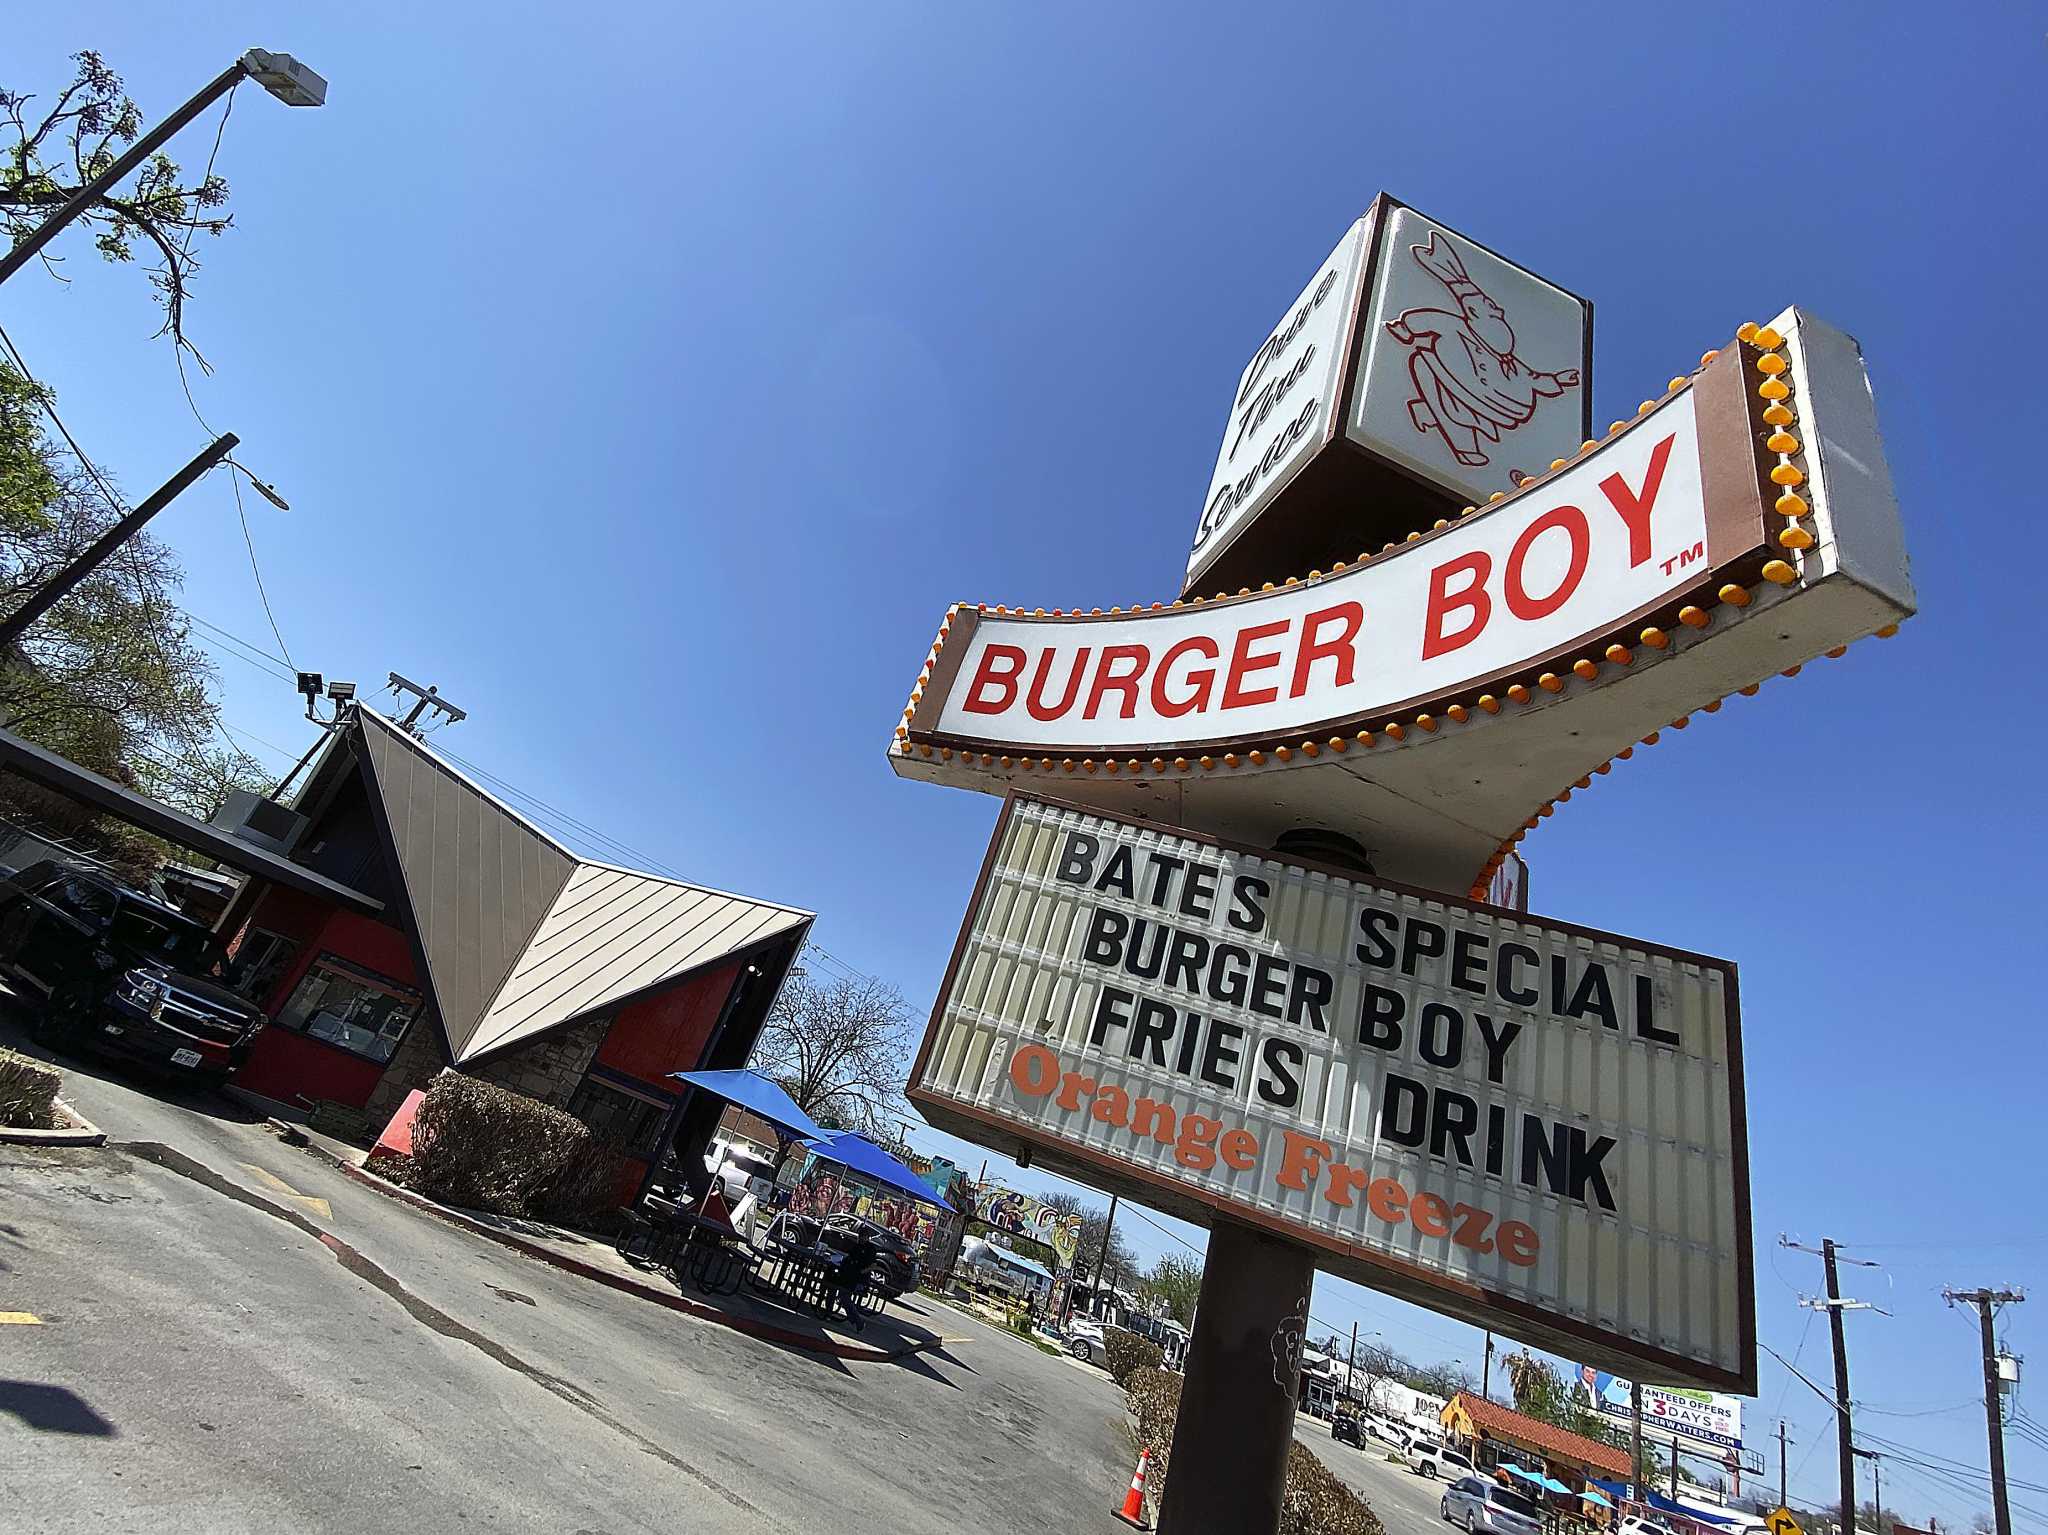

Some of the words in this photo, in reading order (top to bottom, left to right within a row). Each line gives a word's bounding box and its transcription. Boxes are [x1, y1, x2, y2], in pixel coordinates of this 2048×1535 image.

[1229, 344, 1316, 462] Thru
[1238, 269, 1337, 408] Drive
[1192, 398, 1319, 553] Service
[962, 600, 1364, 722] BURGER
[1422, 432, 1677, 661] BOY
[1055, 831, 1271, 933] BATES
[1356, 907, 1680, 1046] SPECIAL
[1083, 907, 1334, 1034] BURGER
[1359, 983, 1522, 1084] BOY
[1010, 1044, 1260, 1170] Orange
[1276, 1130, 1540, 1267] Freeze
[1090, 984, 1303, 1108] FRIES
[1380, 1072, 1617, 1212] DRINK
[1616, 1380, 1685, 1405] GURANTEED
[1689, 1400, 1732, 1418] OFFERS
[1653, 1399, 1666, 1416] 3
[1668, 1407, 1712, 1427] DAYS
